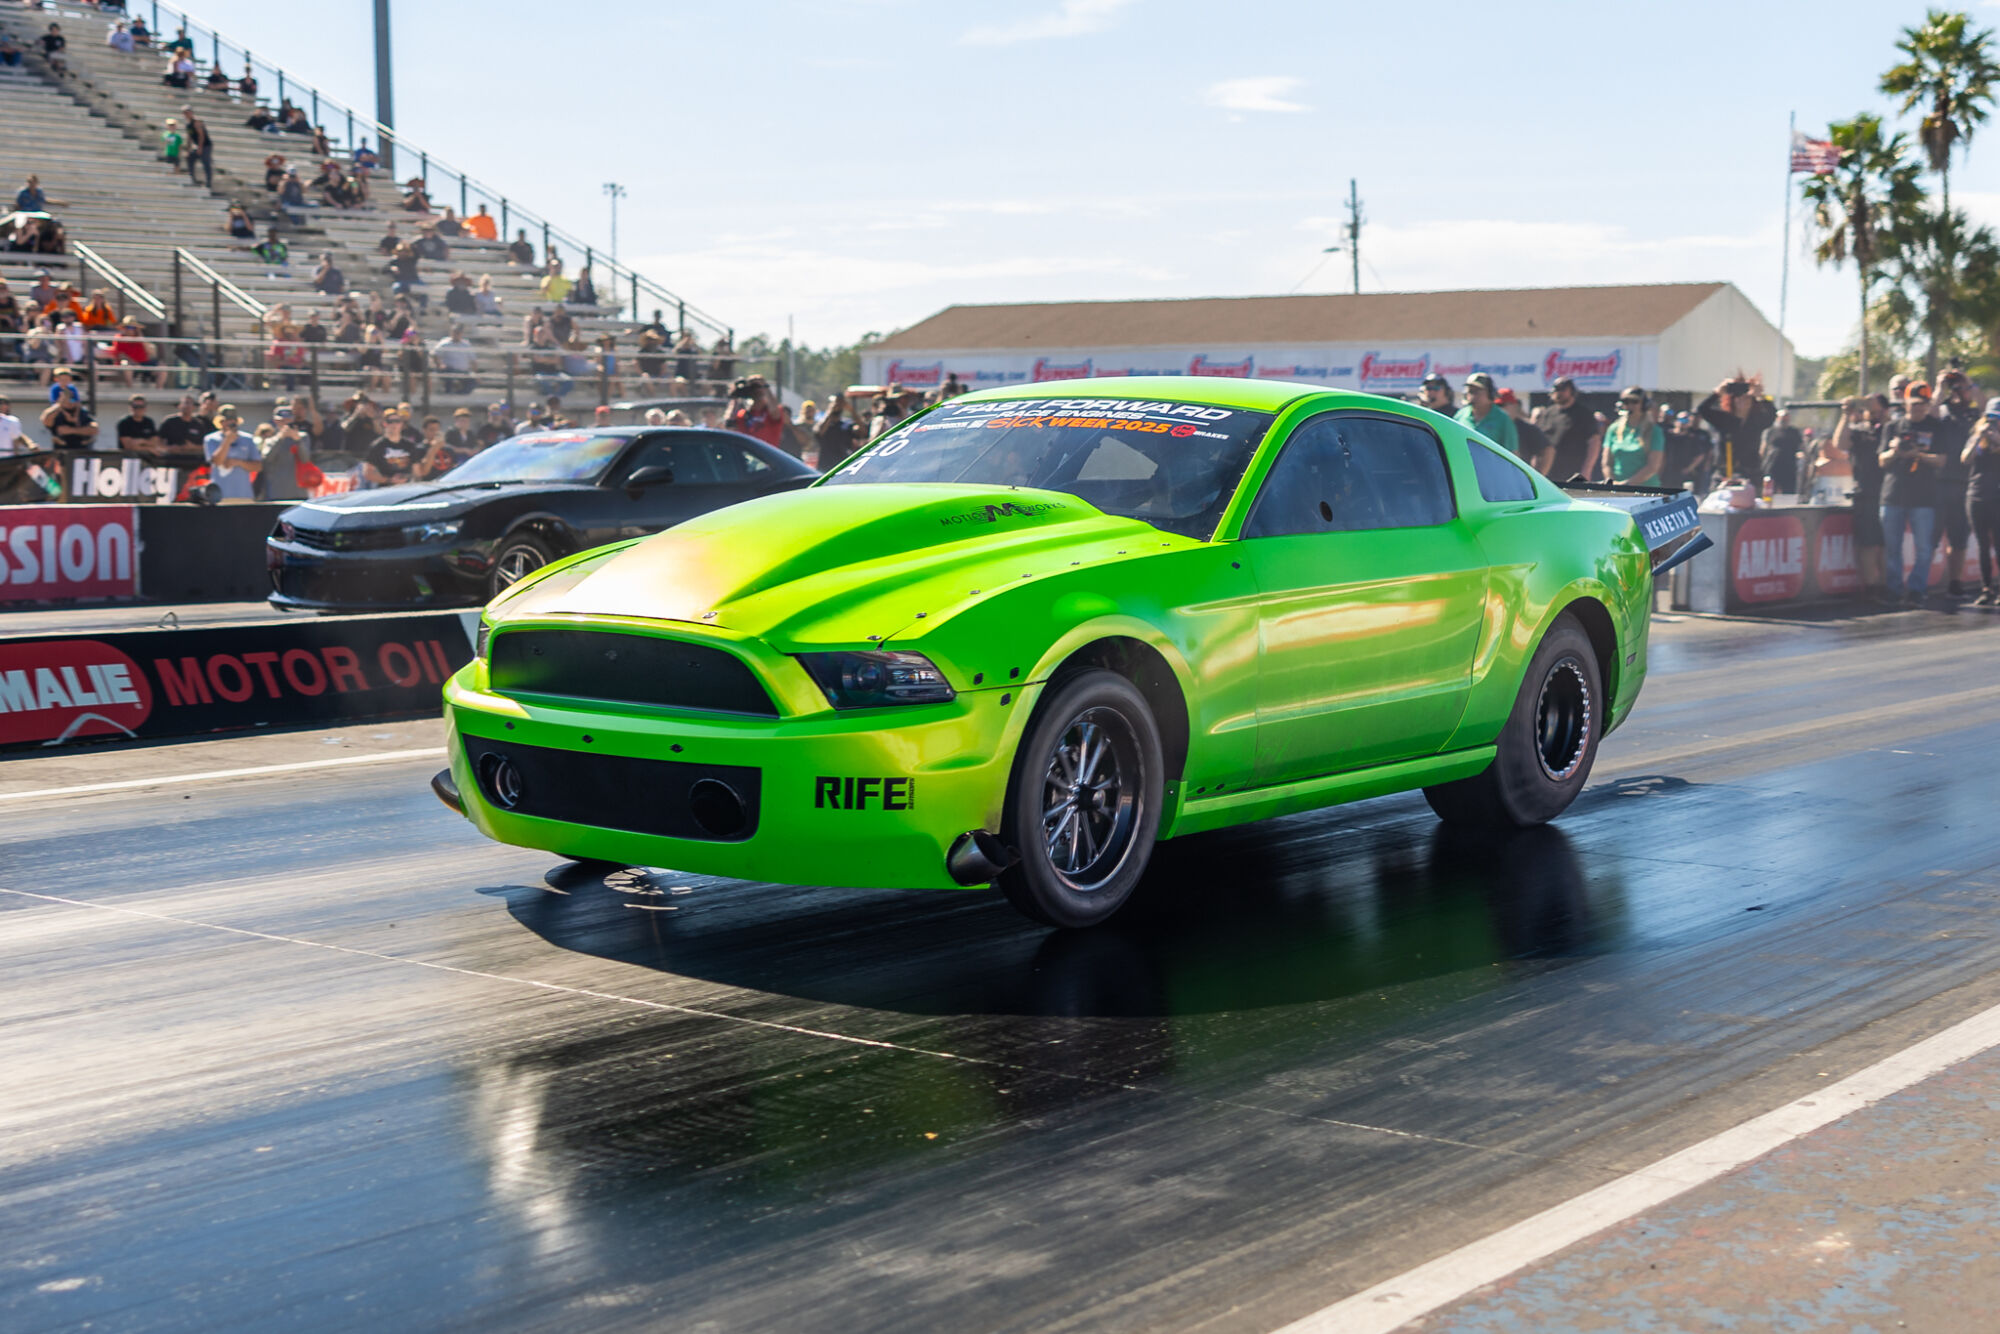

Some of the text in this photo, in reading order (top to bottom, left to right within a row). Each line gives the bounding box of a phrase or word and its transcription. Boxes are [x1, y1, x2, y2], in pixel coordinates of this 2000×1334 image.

[1545, 351, 1617, 381] SUMMIT
[952, 400, 1232, 420] FAST FORWARD
[997, 410, 1147, 420] RACE ENGINES
[1049, 417, 1116, 429] WEEK
[1109, 419, 1172, 433] 2025
[72, 457, 179, 504] Holley
[1737, 536, 1803, 579] AMALIE
[154, 646, 370, 706] MOTOR
[814, 776, 908, 811] RIFE
